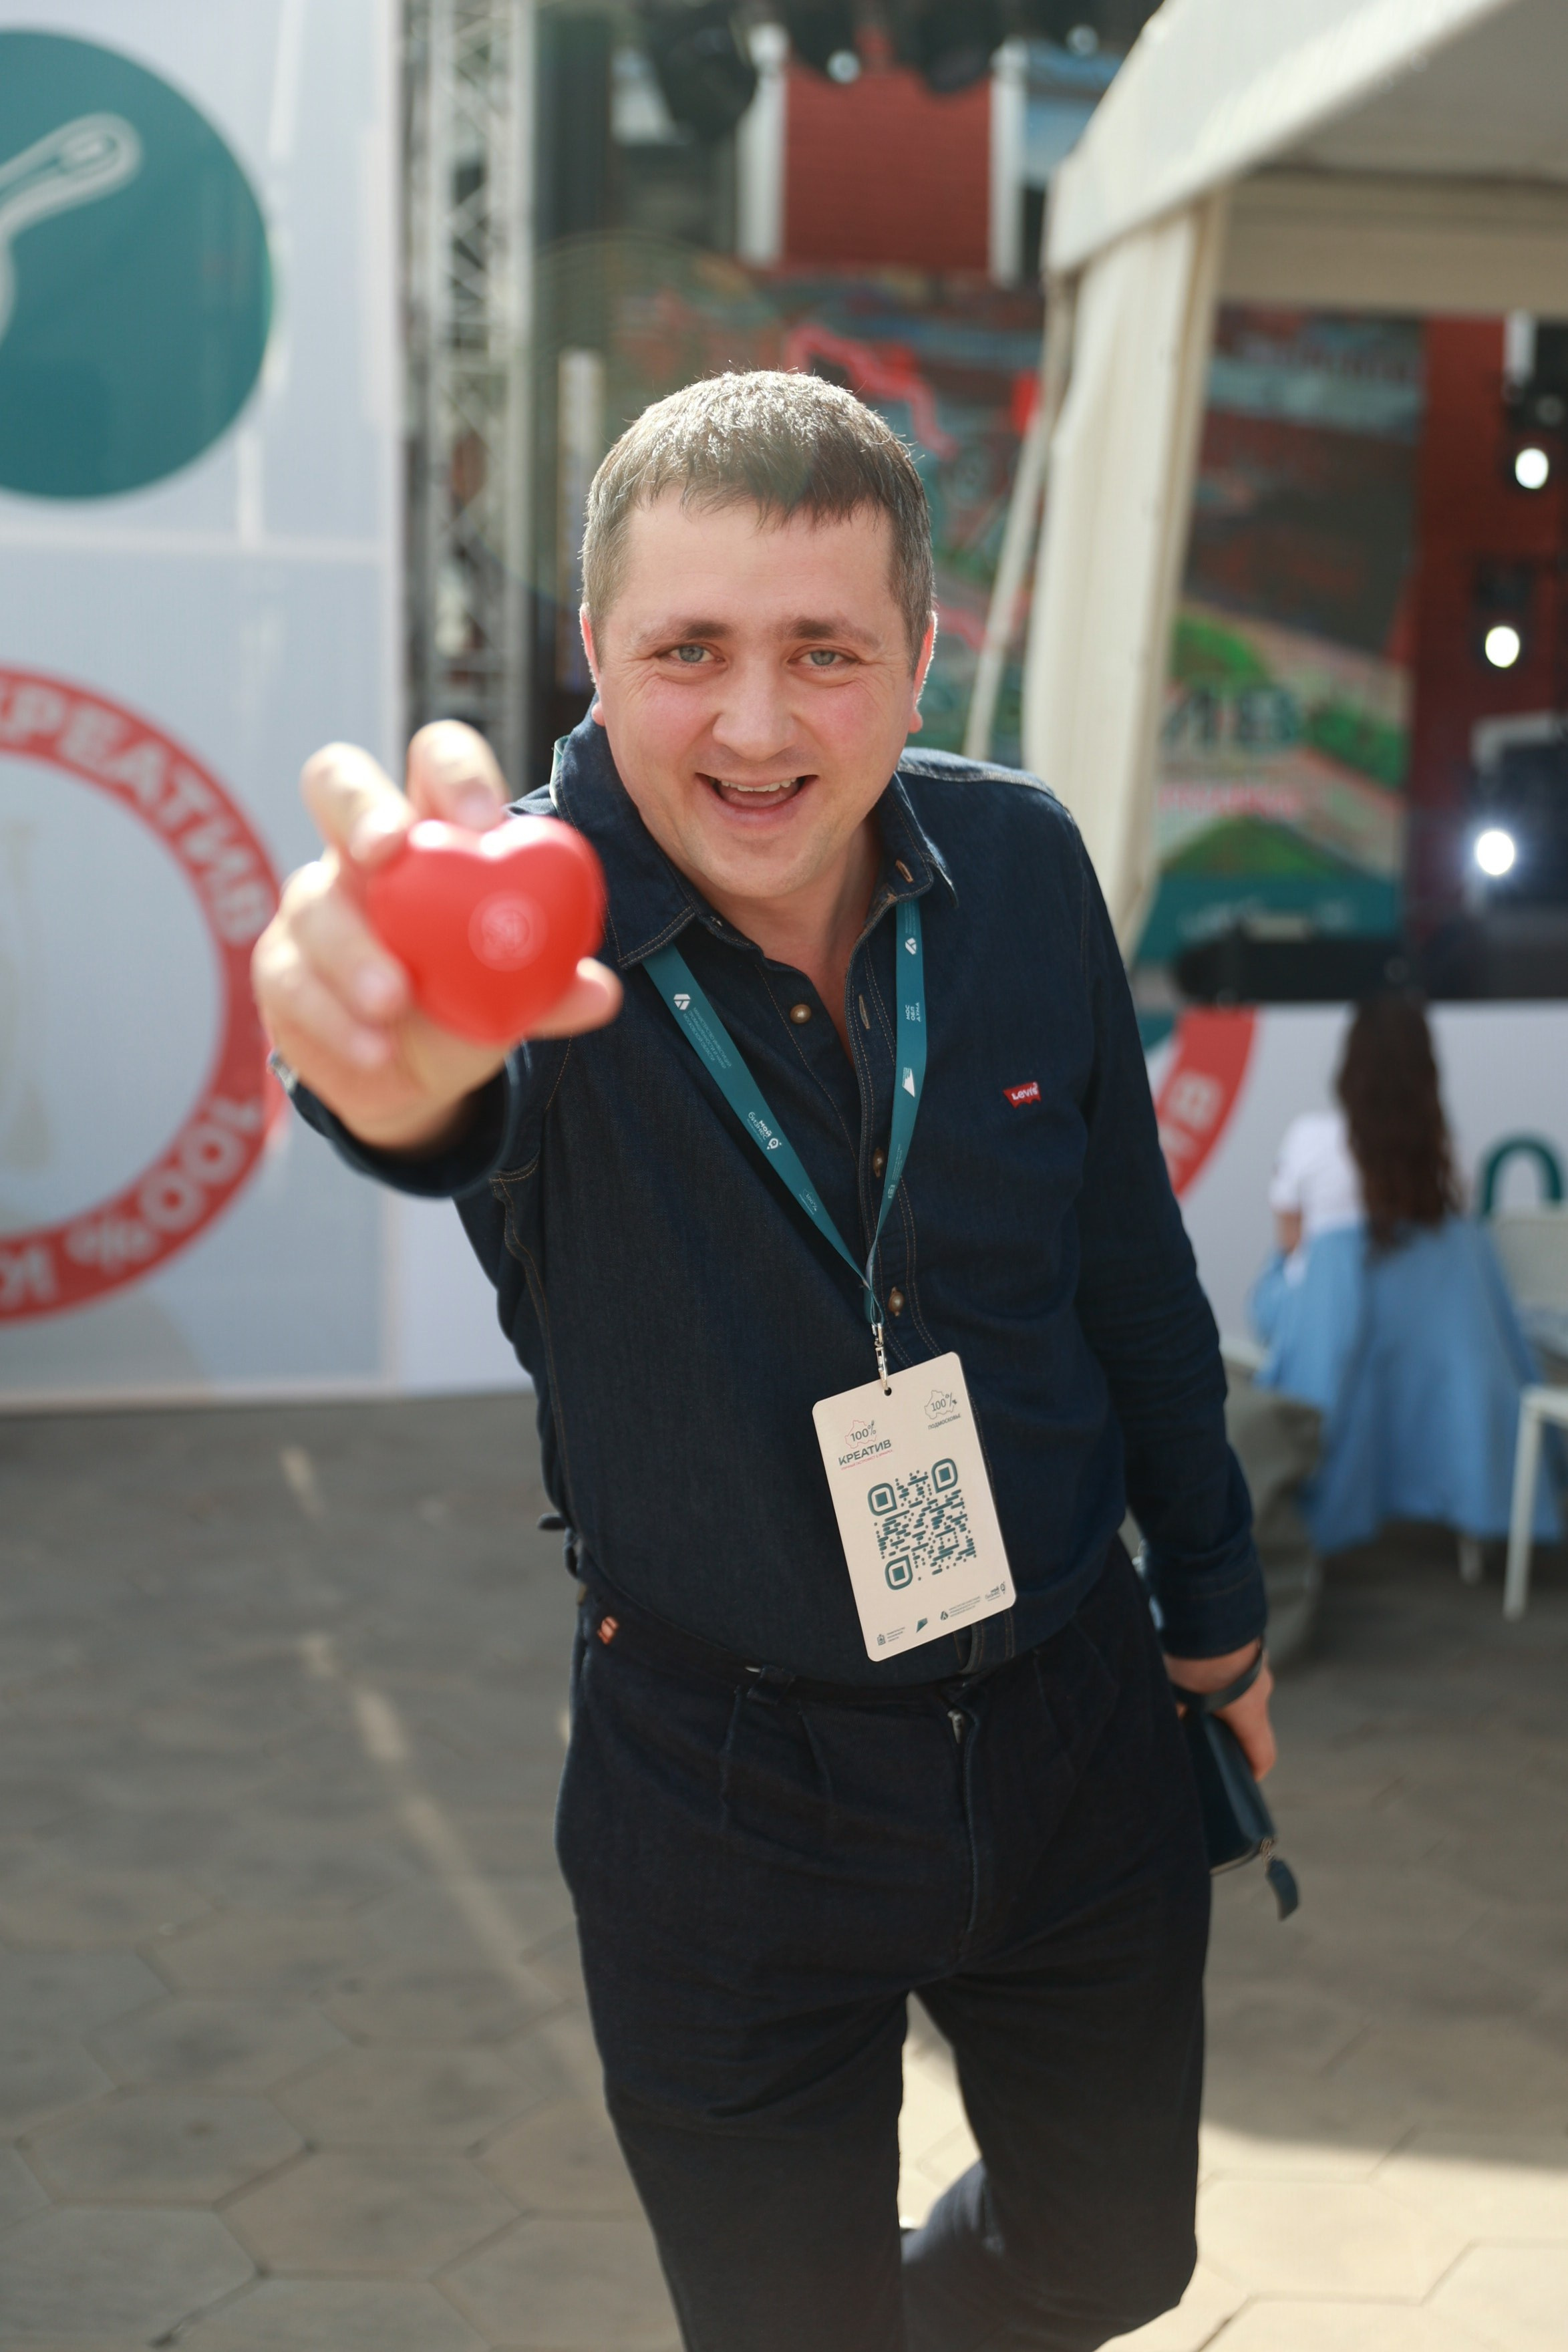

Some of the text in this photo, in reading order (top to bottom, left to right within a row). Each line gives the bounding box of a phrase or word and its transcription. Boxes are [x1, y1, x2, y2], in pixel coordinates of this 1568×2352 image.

[0, 683, 272, 945] РЕАТИВ
[748, 1111, 768, 1141] бизнес
[758, 1120, 772, 1137] мой
[850, 1420, 877, 1442] 100%
[838, 1439, 892, 1465] КРЕАТИВ
